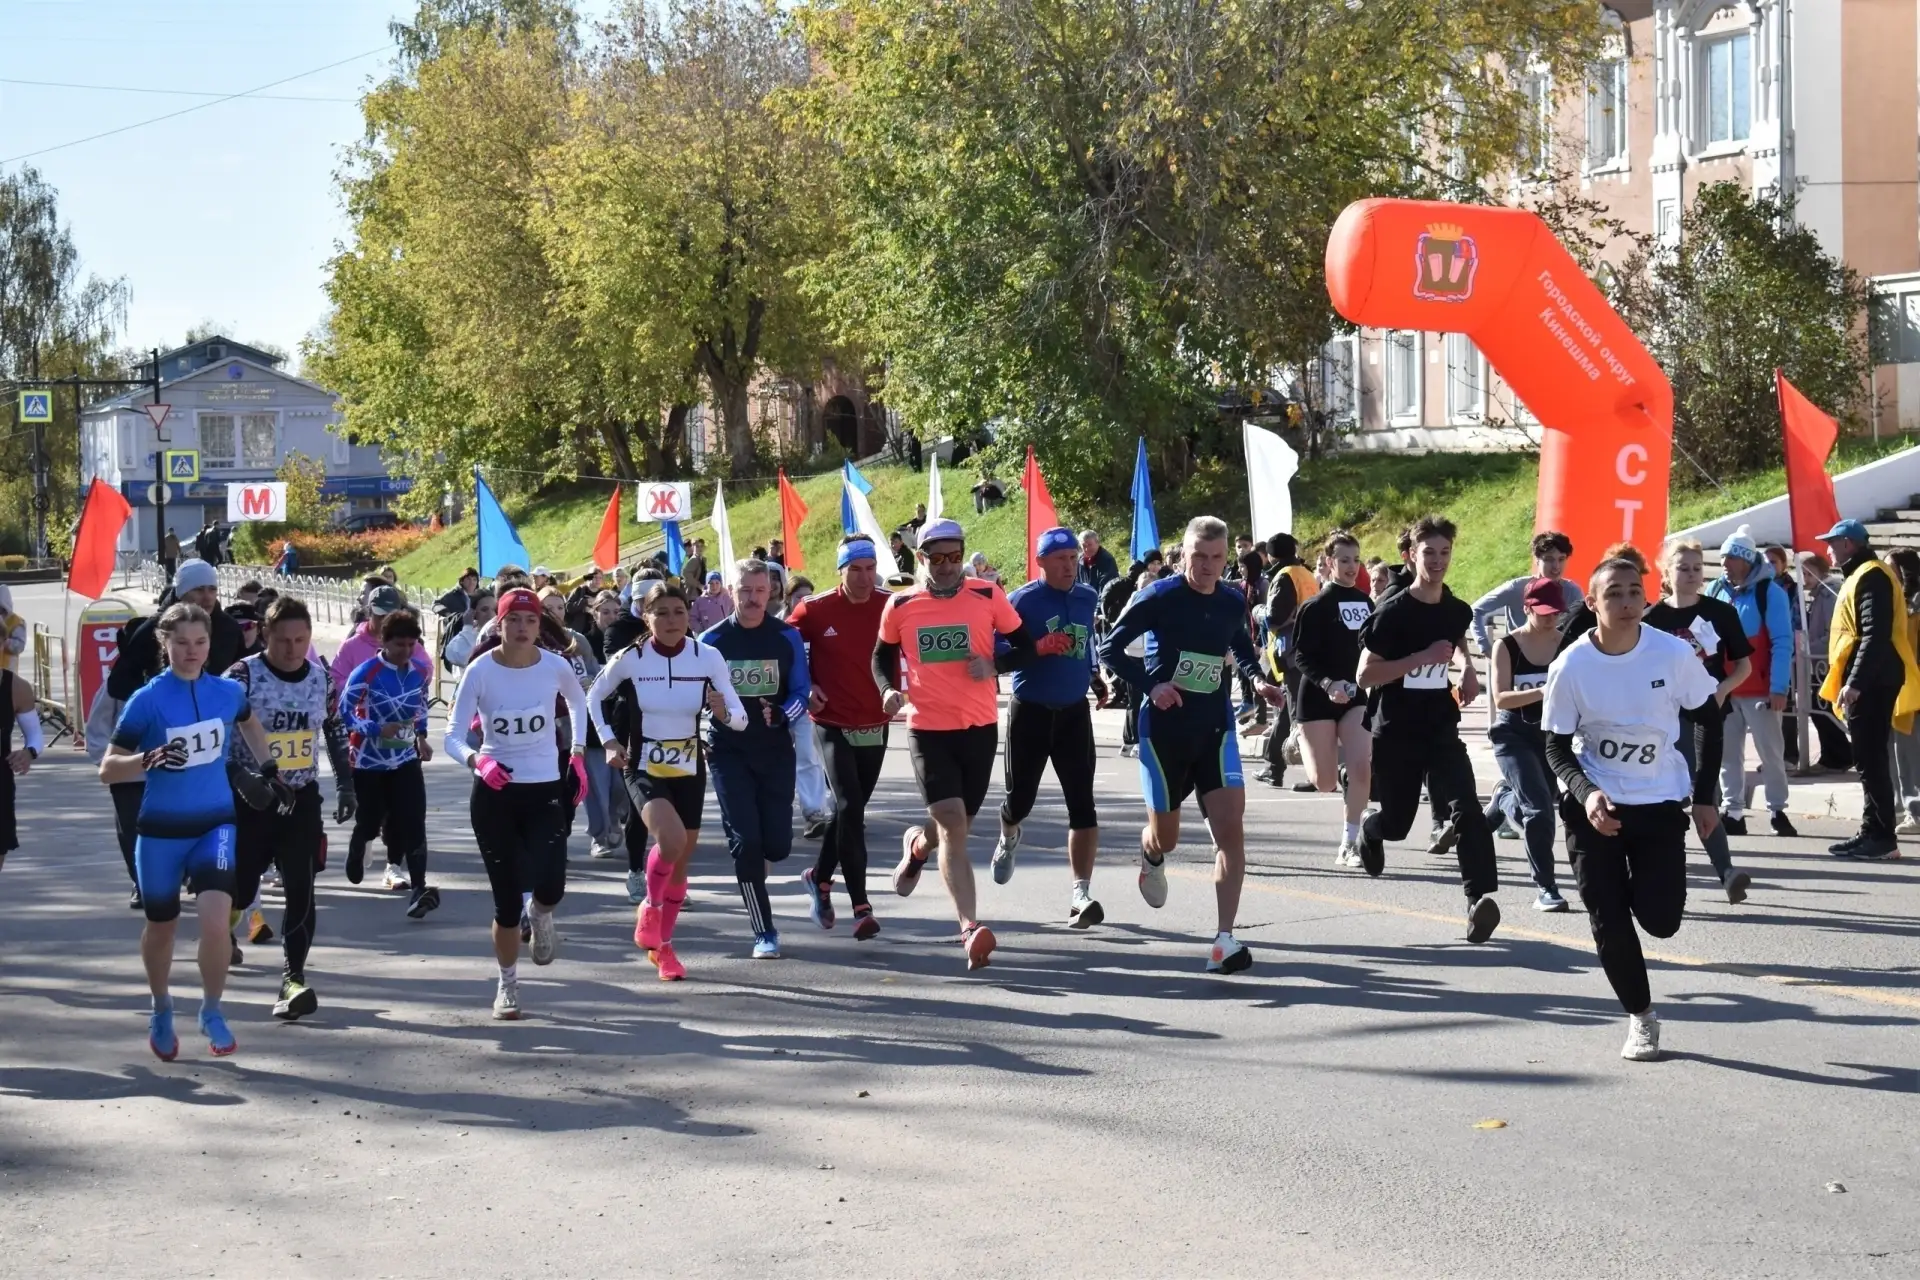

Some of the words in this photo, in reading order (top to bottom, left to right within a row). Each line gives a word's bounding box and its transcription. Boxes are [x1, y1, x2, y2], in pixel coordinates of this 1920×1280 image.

[1537, 269, 1602, 348] Городской
[1599, 346, 1636, 386] округ
[1538, 306, 1601, 381] Кинешма
[243, 489, 270, 514] М
[650, 490, 677, 514] Ж
[1342, 608, 1369, 621] 083
[919, 630, 969, 652] 962
[729, 667, 777, 686] 961
[1178, 659, 1222, 683] 975
[272, 711, 309, 730] GYM
[493, 715, 545, 736] 210
[269, 738, 312, 759] 615
[648, 743, 696, 765] 027
[1599, 739, 1656, 765] 078
[217, 828, 229, 871] SPINE
